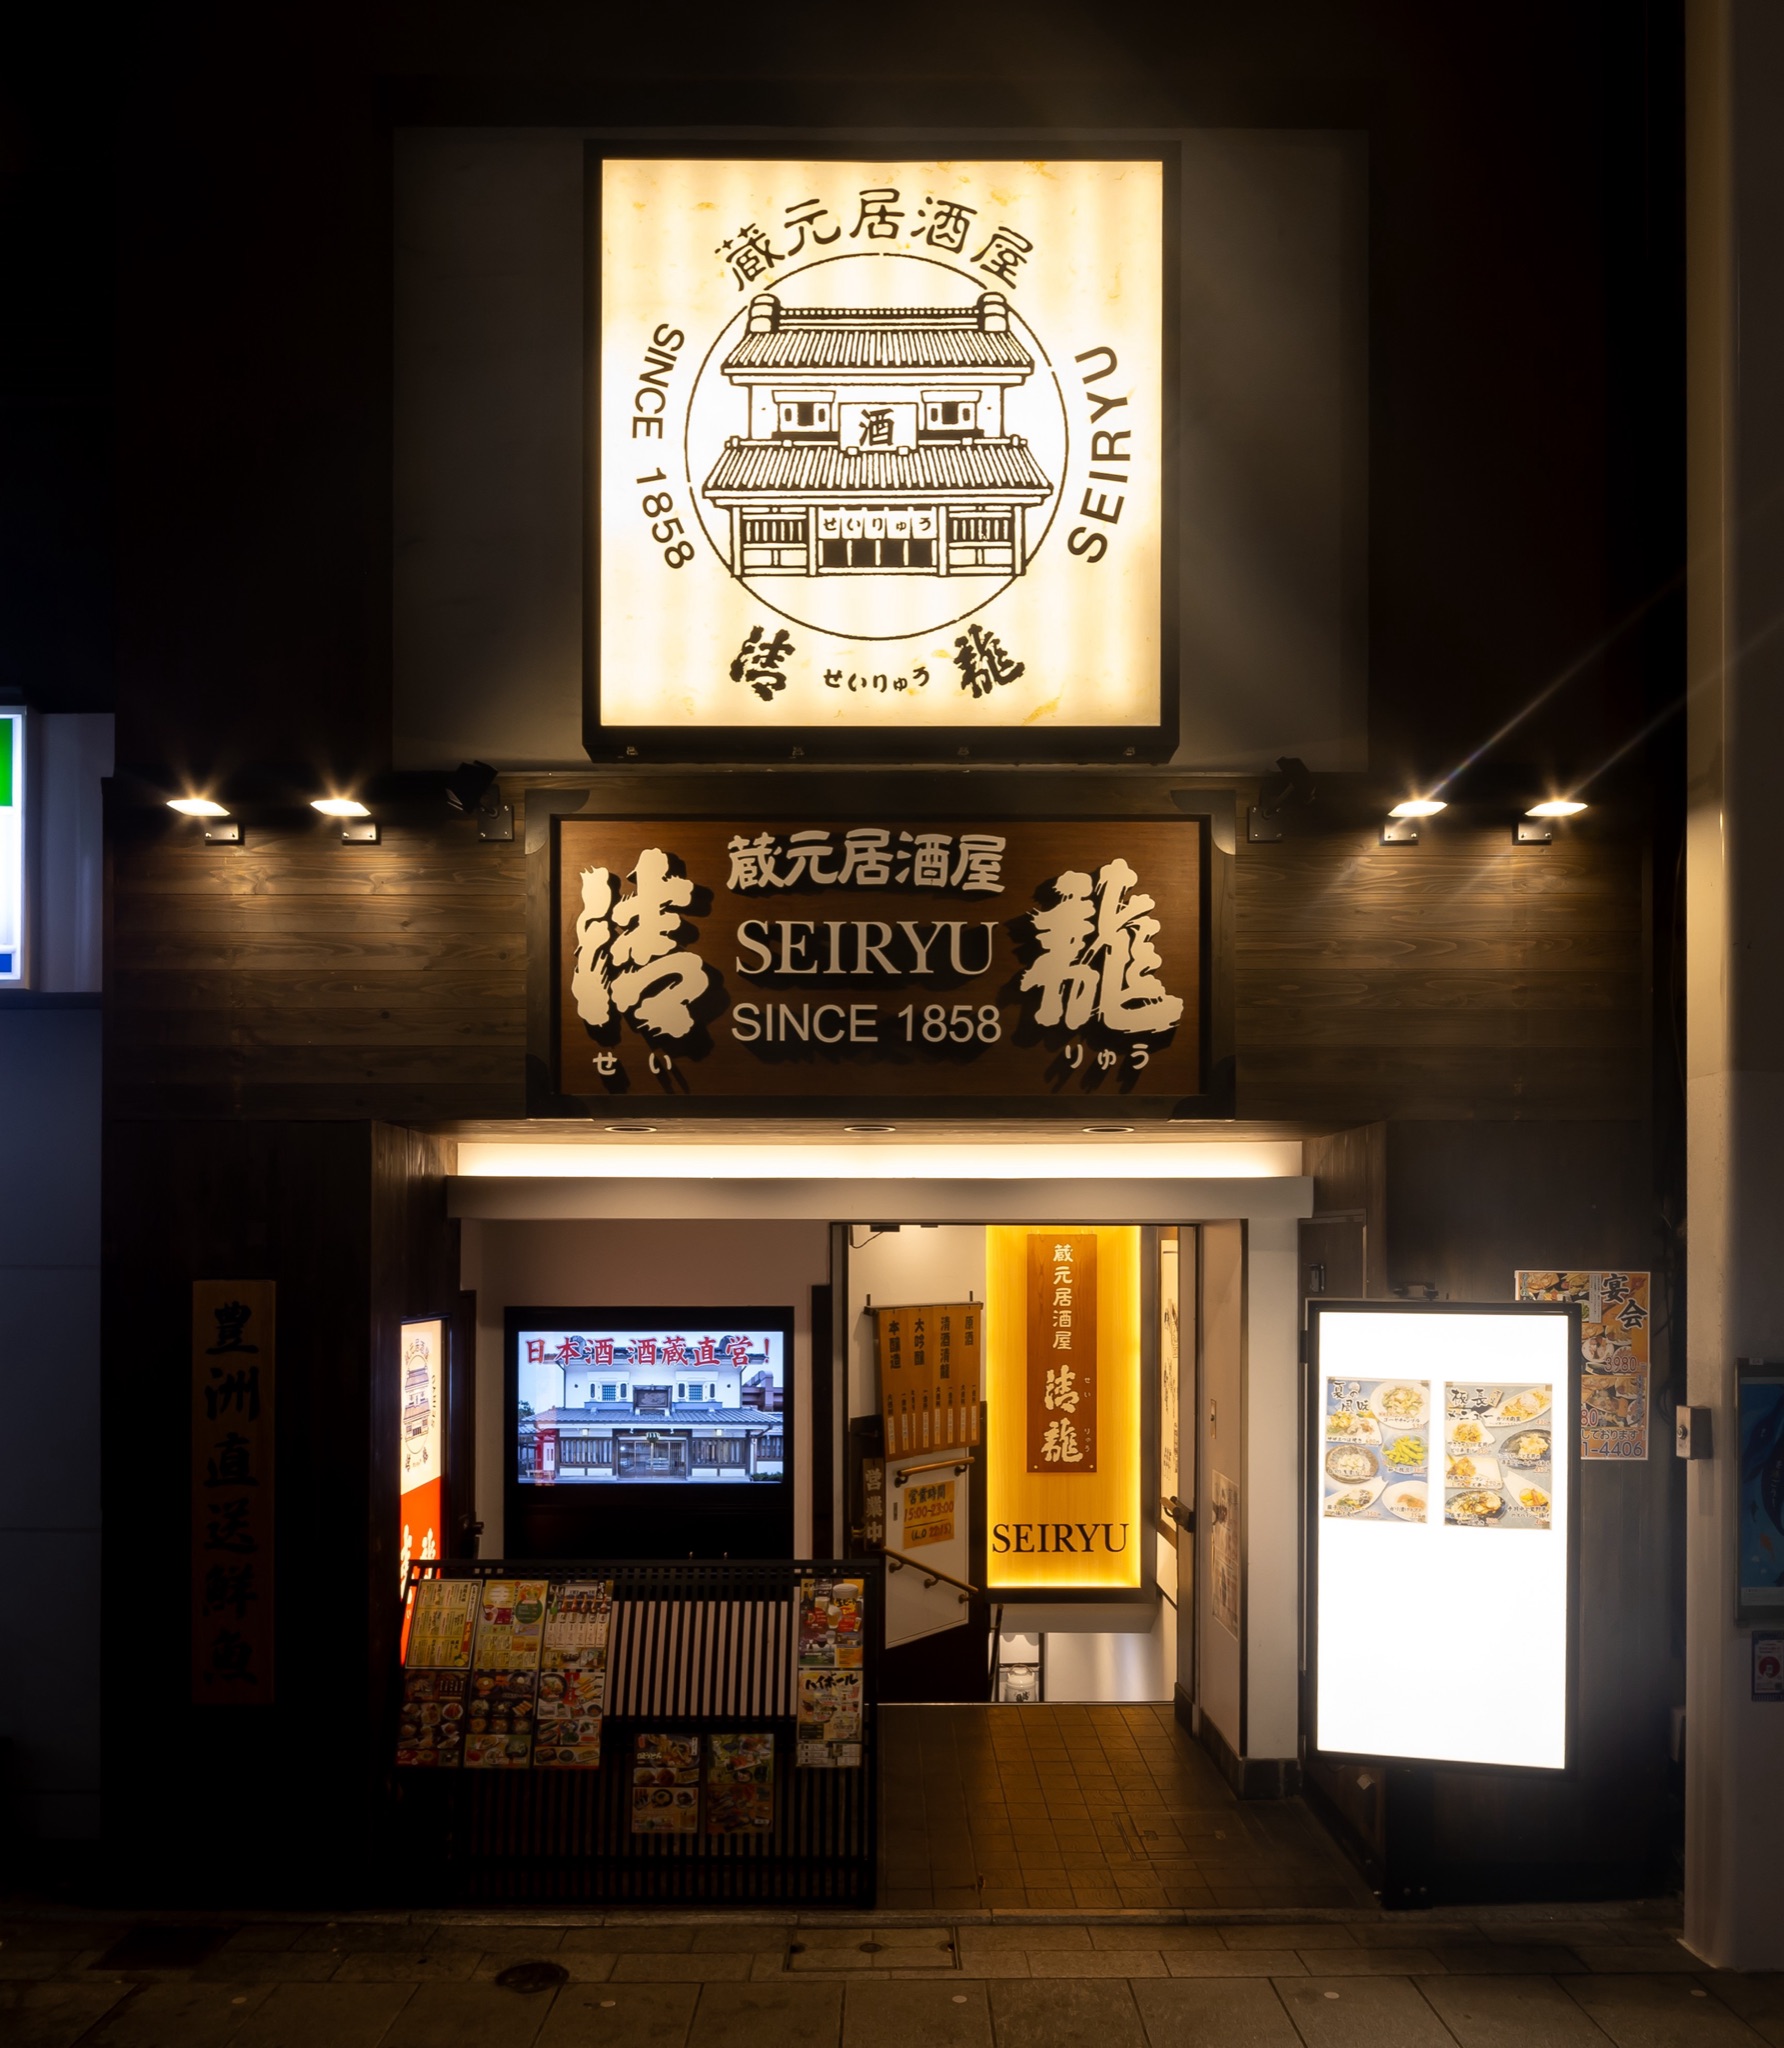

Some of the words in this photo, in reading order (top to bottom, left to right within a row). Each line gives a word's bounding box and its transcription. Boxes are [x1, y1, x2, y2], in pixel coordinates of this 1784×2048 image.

[714, 187, 1035, 292] 蔵元居酒屋
[631, 322, 685, 441] SINCE
[857, 408, 896, 448] 酒
[1067, 345, 1132, 565] SEIRYU
[635, 465, 696, 570] 1858
[822, 515, 932, 533] せいりゅう
[822, 668, 931, 696] せいりゅう
[726, 828, 1008, 894] 蔵元居酒屋
[734, 918, 999, 976] SEIRYU
[731, 1003, 879, 1044] SINCE
[897, 1003, 1002, 1044] 1858
[591, 1050, 673, 1077] せい
[1064, 1043, 1151, 1071] りゅう
[1052, 1244, 1074, 1350] 蔵元居酒屋
[1601, 1273, 1648, 1328] 宴会
[965, 1316, 974, 1345] 原酒
[526, 1336, 615, 1366] 日本酒
[1448, 1410, 1494, 1421] メニュー
[204, 1301, 259, 1684] 豊洲直送鮮魚
[865, 1468, 883, 1543] 営業中
[909, 1484, 946, 1505] 営業時間
[992, 1523, 1130, 1554] SEIRYU
[806, 1673, 858, 1690] ハイボール
